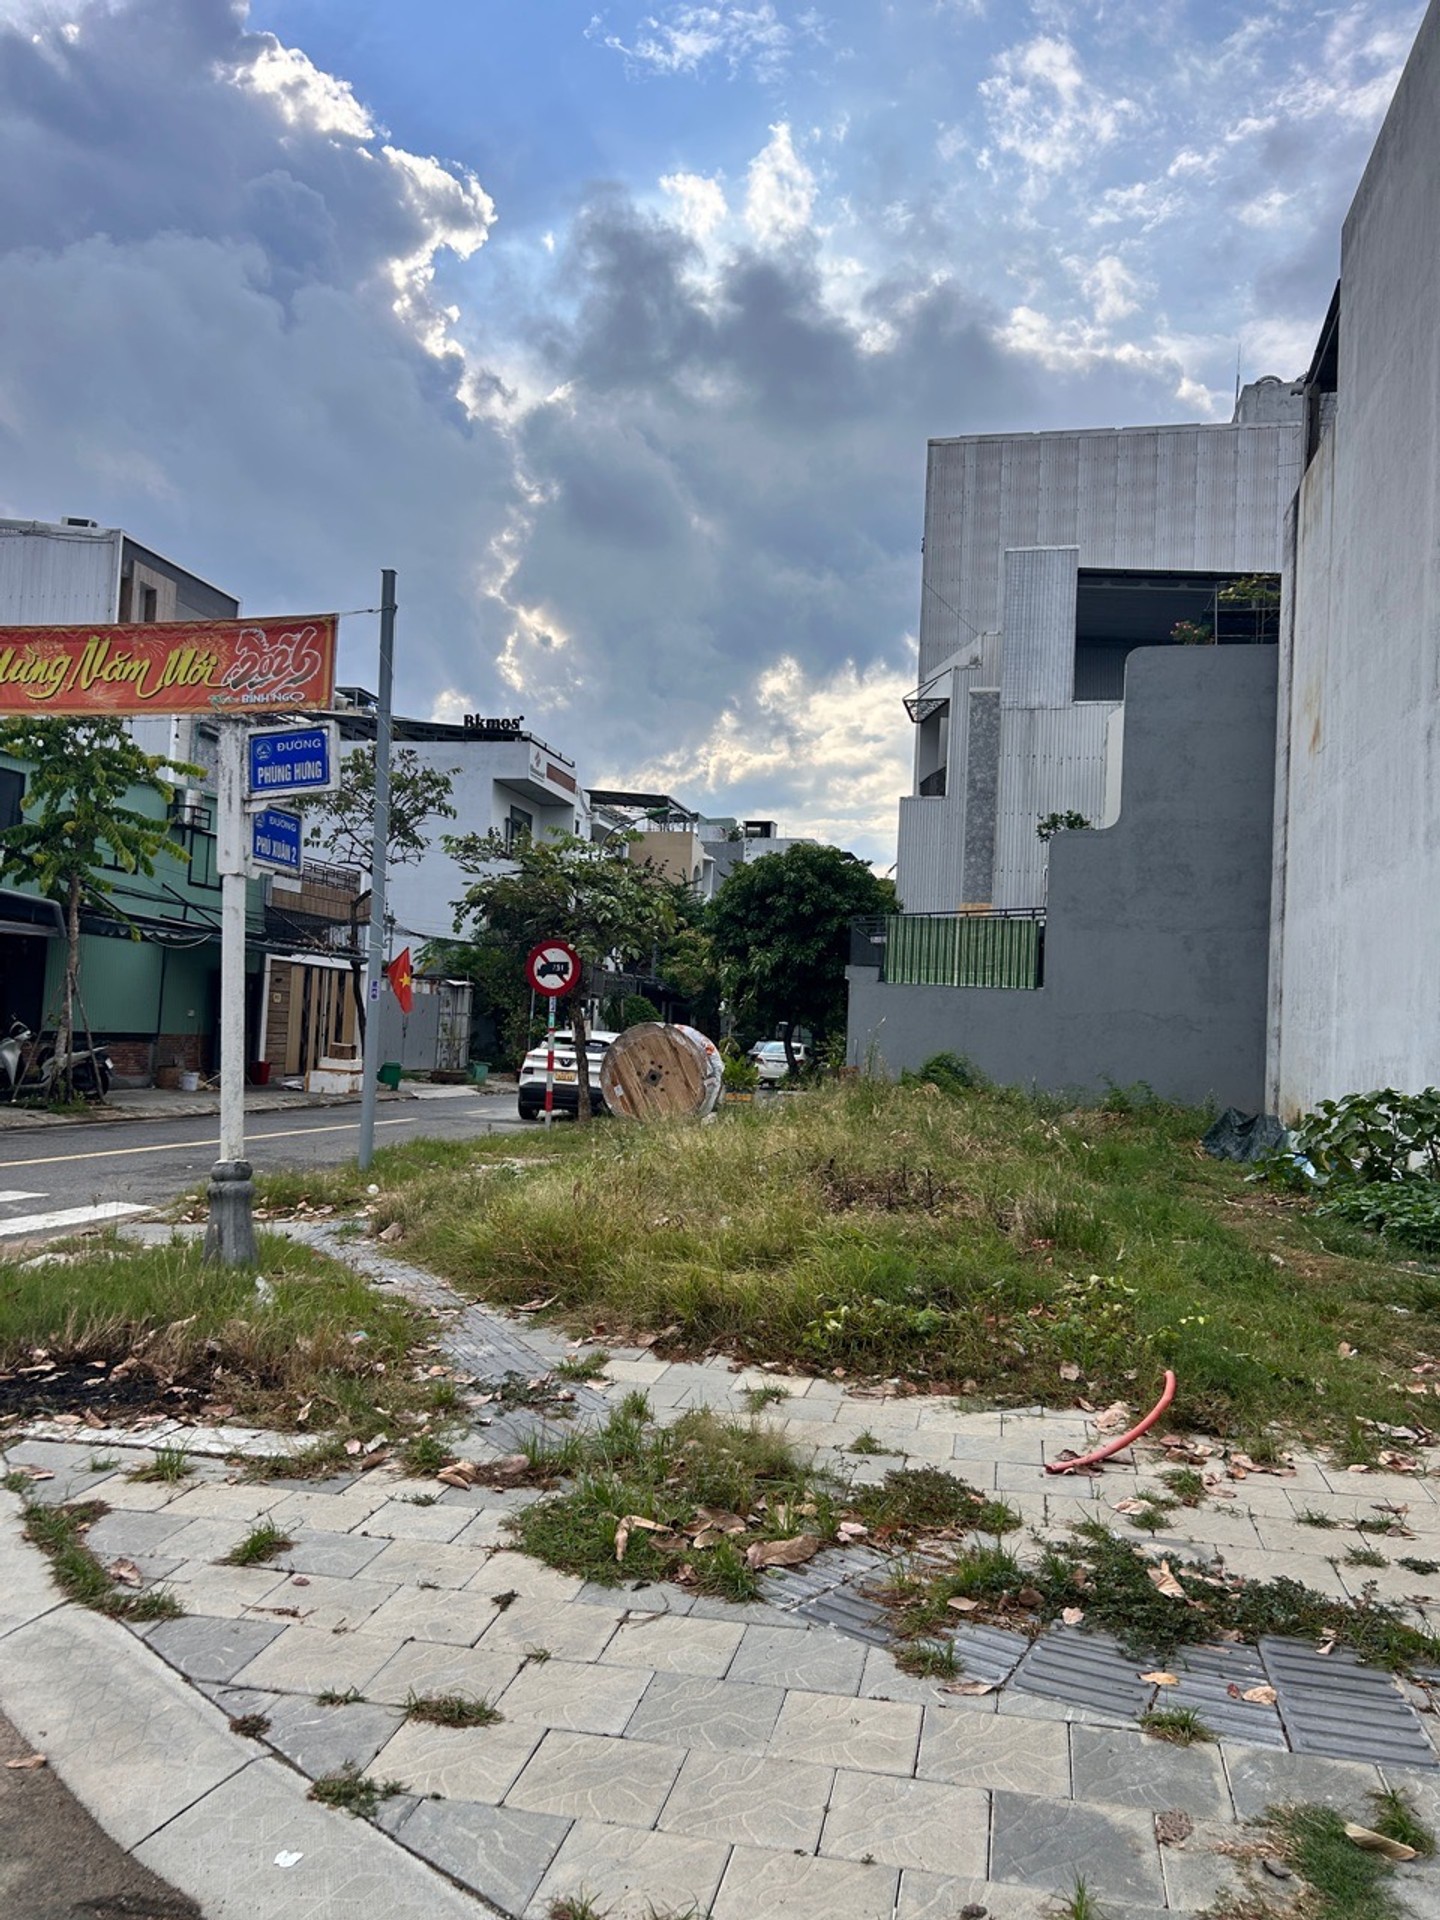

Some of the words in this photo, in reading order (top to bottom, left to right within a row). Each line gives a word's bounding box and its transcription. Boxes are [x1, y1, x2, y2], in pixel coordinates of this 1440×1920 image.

[67, 634, 165, 698] Năm
[161, 648, 227, 687] Mới
[221, 626, 322, 692] 2026
[276, 737, 322, 752] ĐƯỜNG
[257, 761, 292, 785] PHÙNG
[291, 846, 297, 863] 2
